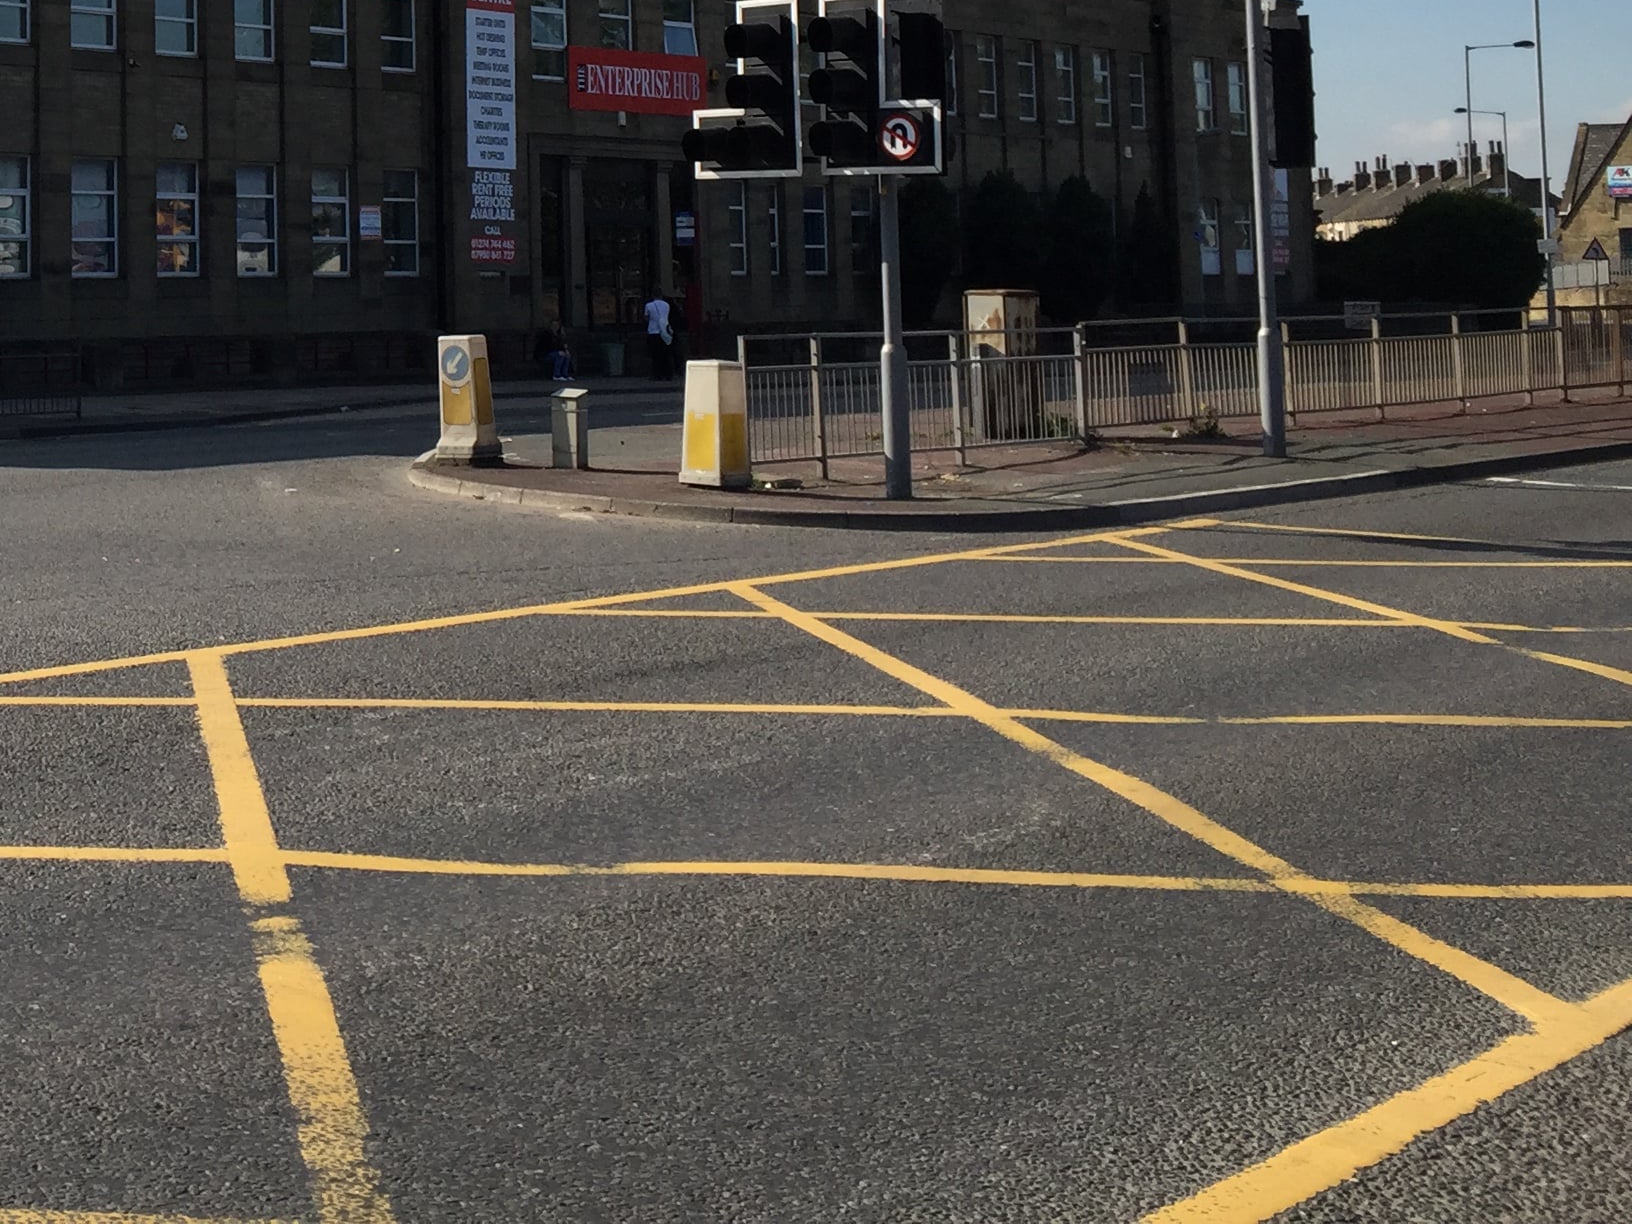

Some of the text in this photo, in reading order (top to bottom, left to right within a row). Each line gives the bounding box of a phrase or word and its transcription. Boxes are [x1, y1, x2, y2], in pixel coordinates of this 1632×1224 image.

[586, 64, 671, 99] ENTERPRISE
[672, 71, 701, 101] HUB
[474, 171, 510, 185] FLEXIBLE
[472, 183, 514, 197] RENT FREE
[474, 195, 511, 208] PERIODS
[470, 207, 515, 221] AVAILABLE
